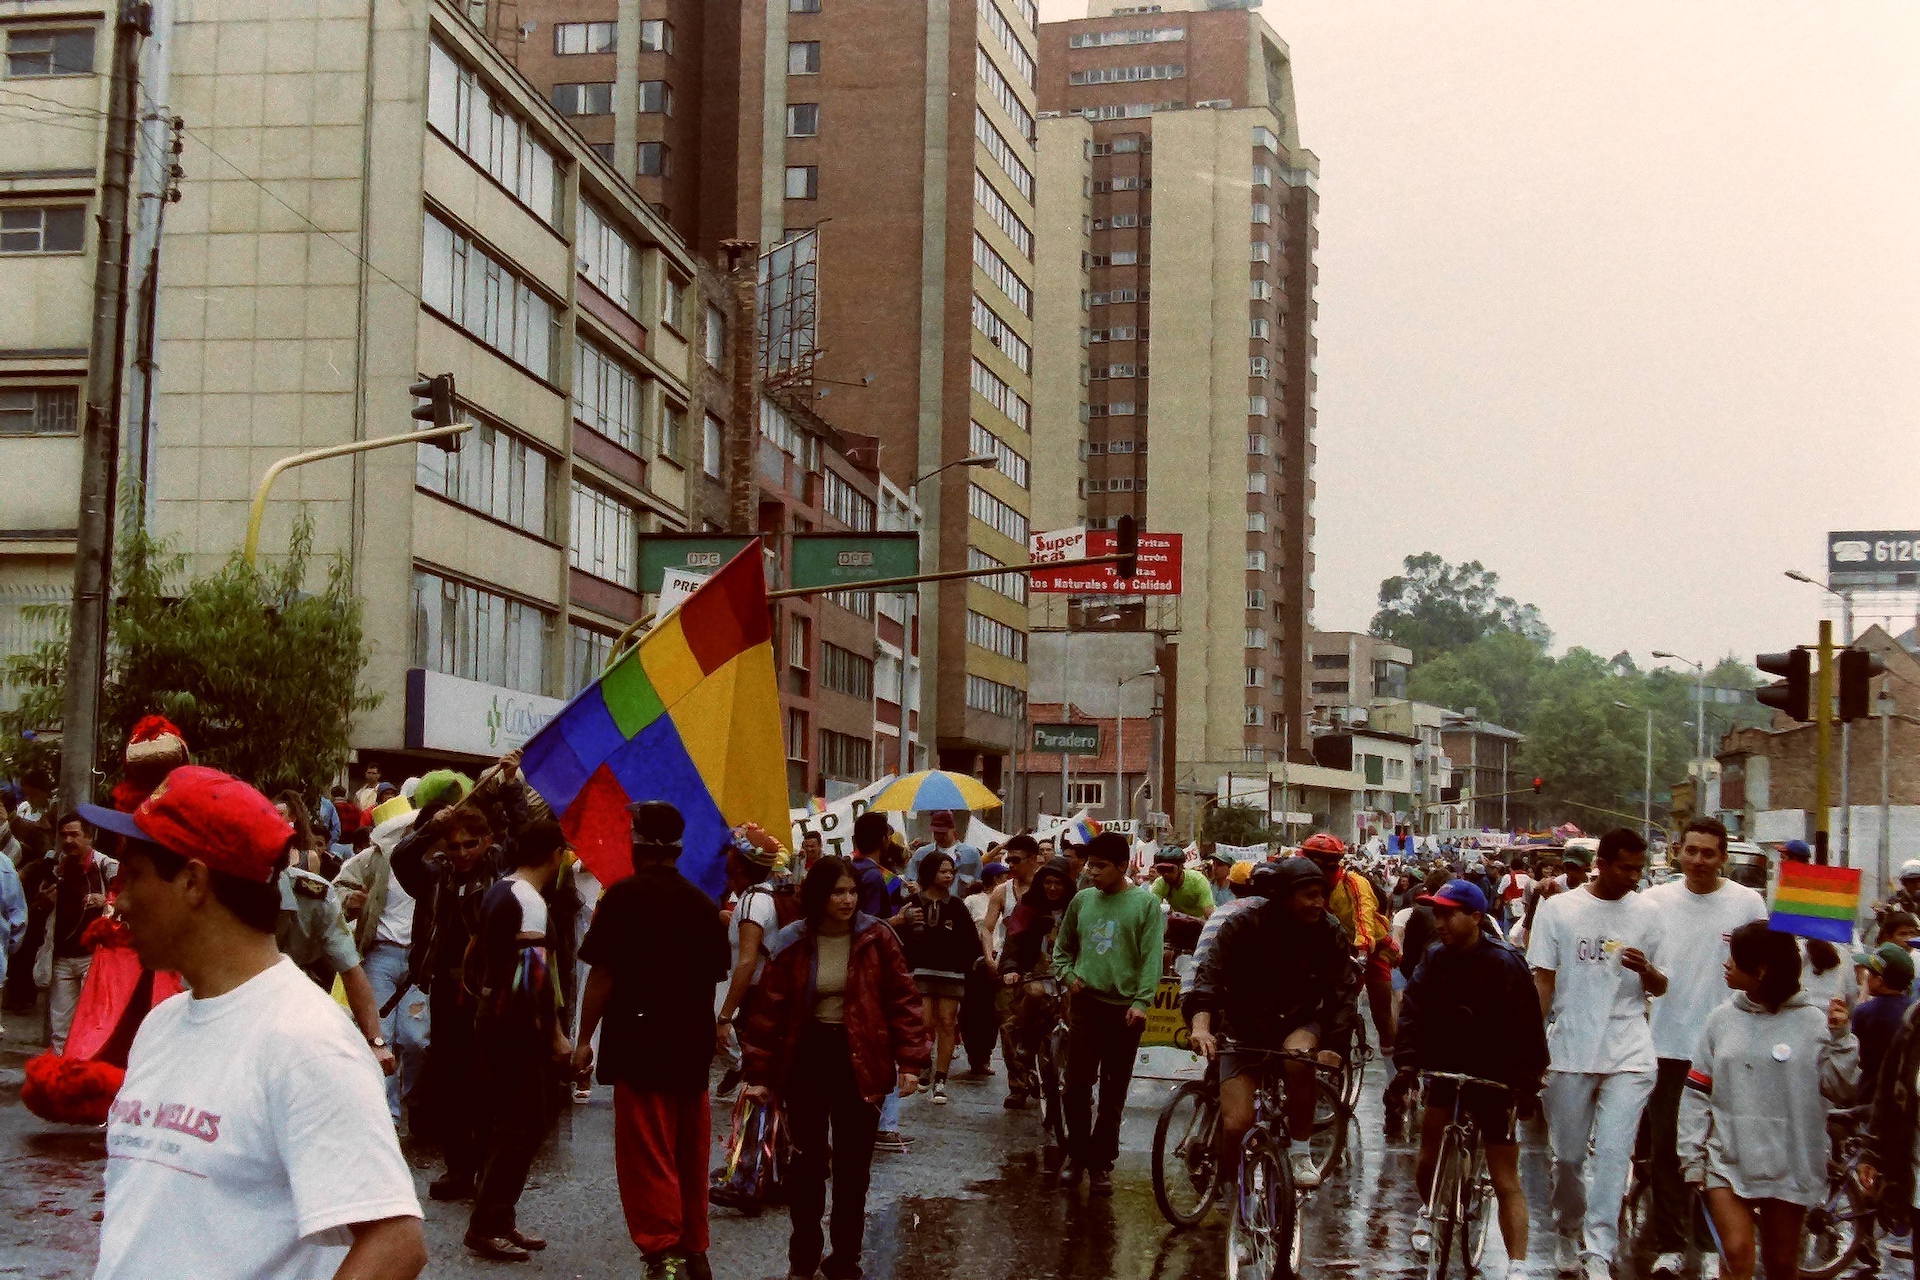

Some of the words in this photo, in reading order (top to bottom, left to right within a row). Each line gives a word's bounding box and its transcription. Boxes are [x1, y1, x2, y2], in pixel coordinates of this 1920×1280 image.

[1036, 534, 1083, 551] Super
[1137, 538, 1170, 547] Fritas
[673, 579, 702, 592] PRE
[1054, 579, 1107, 590] Naturales
[1113, 580, 1126, 590] de
[1132, 579, 1172, 590] Calidad
[1035, 730, 1096, 748] Paradero
